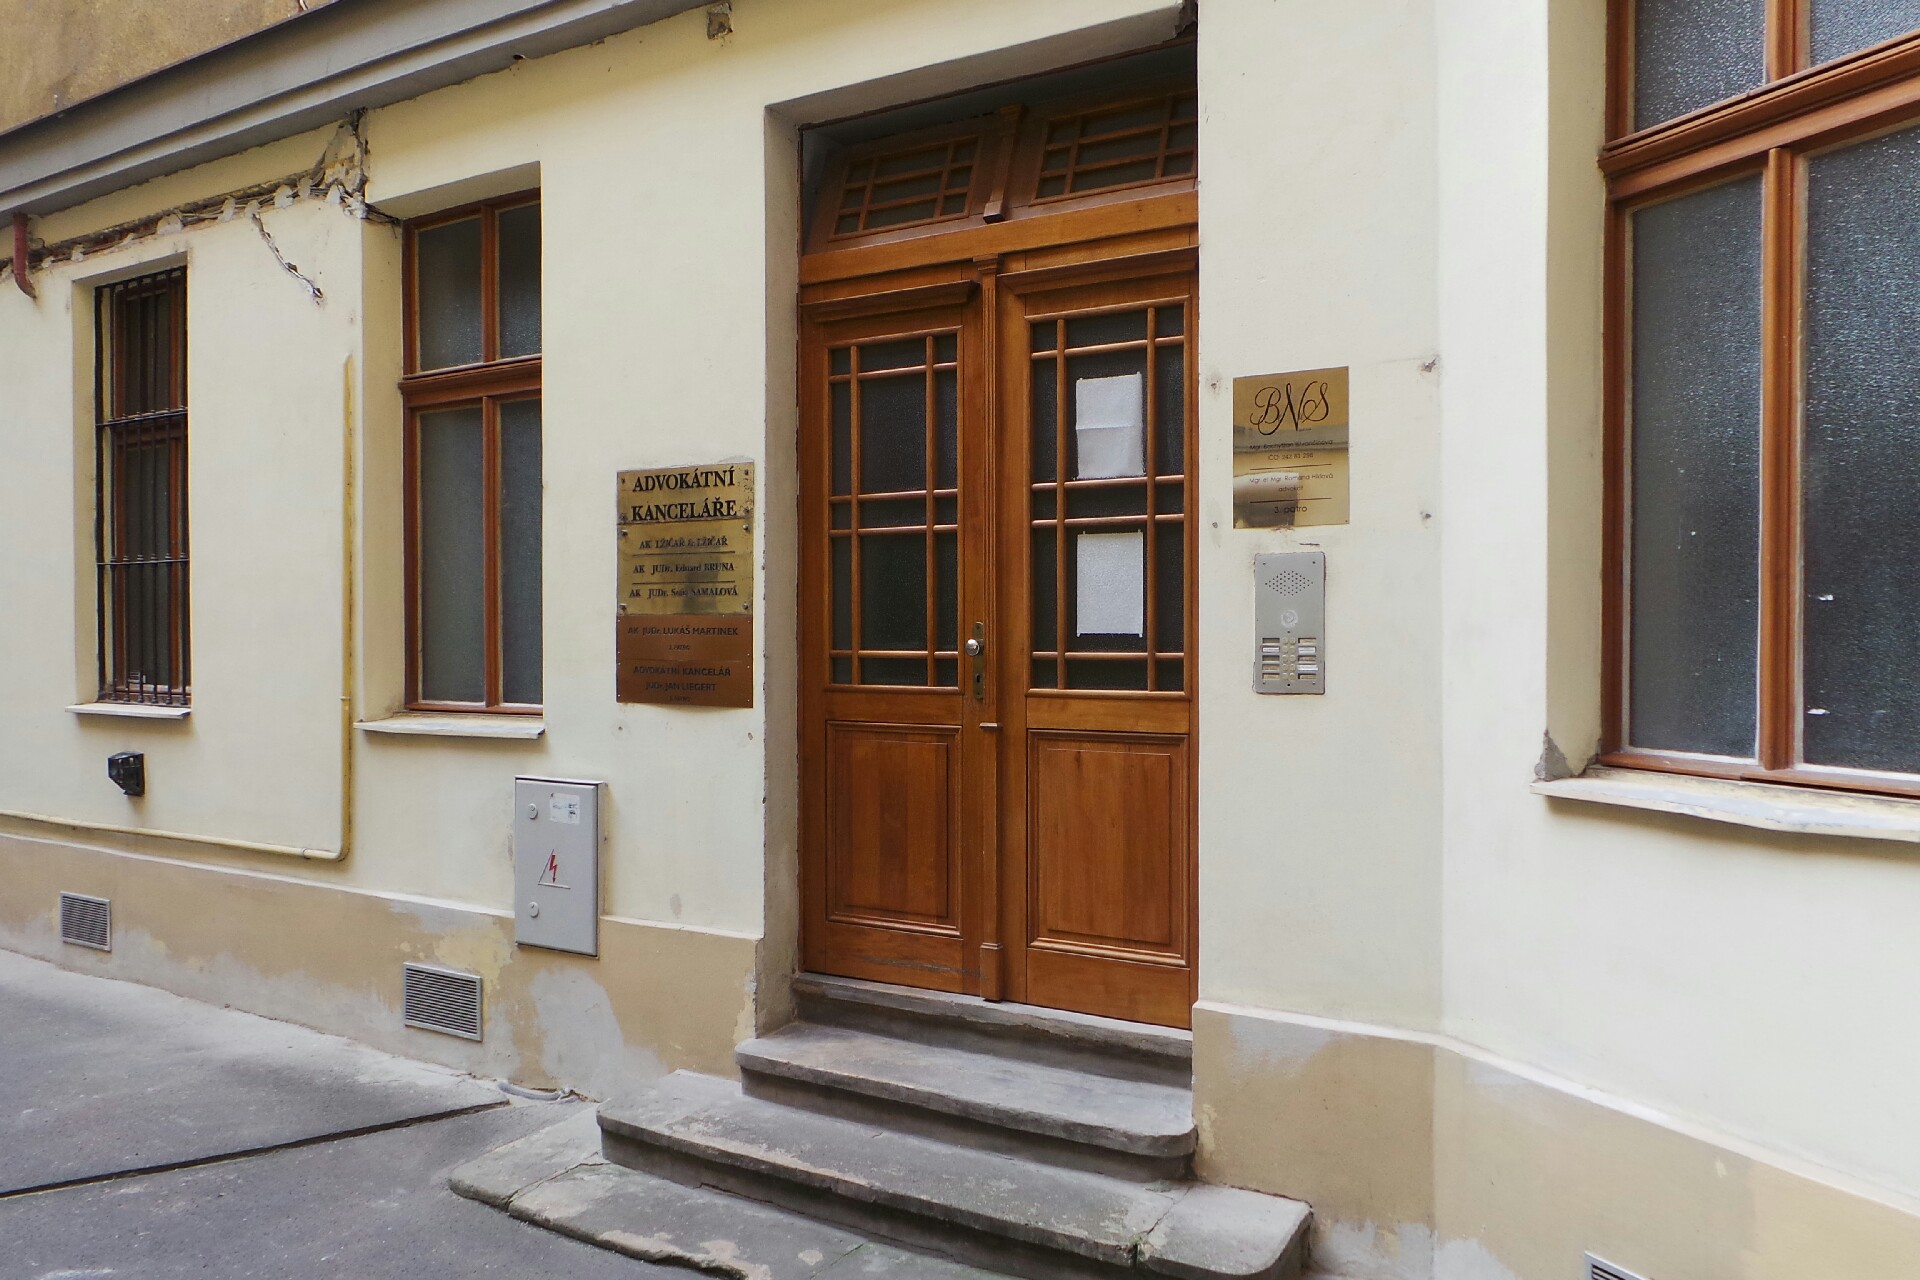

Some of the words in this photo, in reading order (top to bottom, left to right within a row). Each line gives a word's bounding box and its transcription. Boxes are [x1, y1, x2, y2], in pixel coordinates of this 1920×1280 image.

[632, 466, 736, 493] ADVOKÁTNÍ
[631, 497, 738, 522] KANCELÁŘE
[1283, 505, 1308, 515] patro
[639, 540, 651, 549] AK
[633, 565, 645, 574] AK
[651, 564, 673, 575] JUDr.
[675, 563, 702, 572] Eduard
[629, 589, 641, 598] AK
[647, 588, 669, 599] JUDr.
[663, 625, 690, 635] LUKÁŠ
[692, 627, 738, 636] MARTINEK
[664, 682, 680, 692] JAN
[682, 682, 717, 691] LIEGERT
